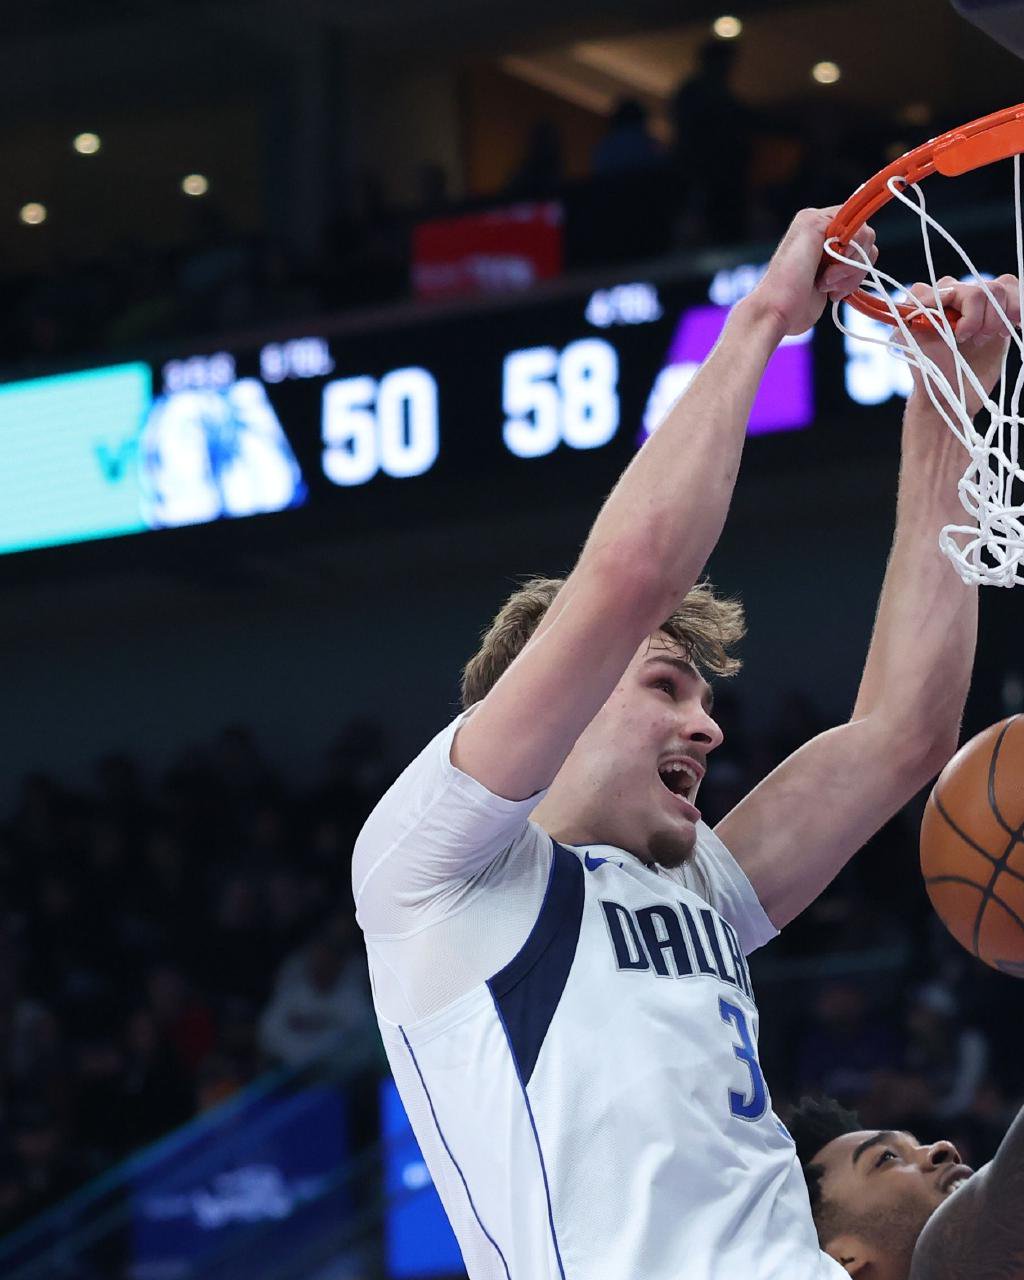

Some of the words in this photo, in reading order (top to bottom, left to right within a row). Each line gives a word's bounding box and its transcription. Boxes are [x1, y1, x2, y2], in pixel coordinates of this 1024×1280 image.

[321, 366, 439, 487] 50
[502, 336, 620, 458] 58
[599, 898, 755, 1001] DALLA
[718, 995, 769, 1123] 3
